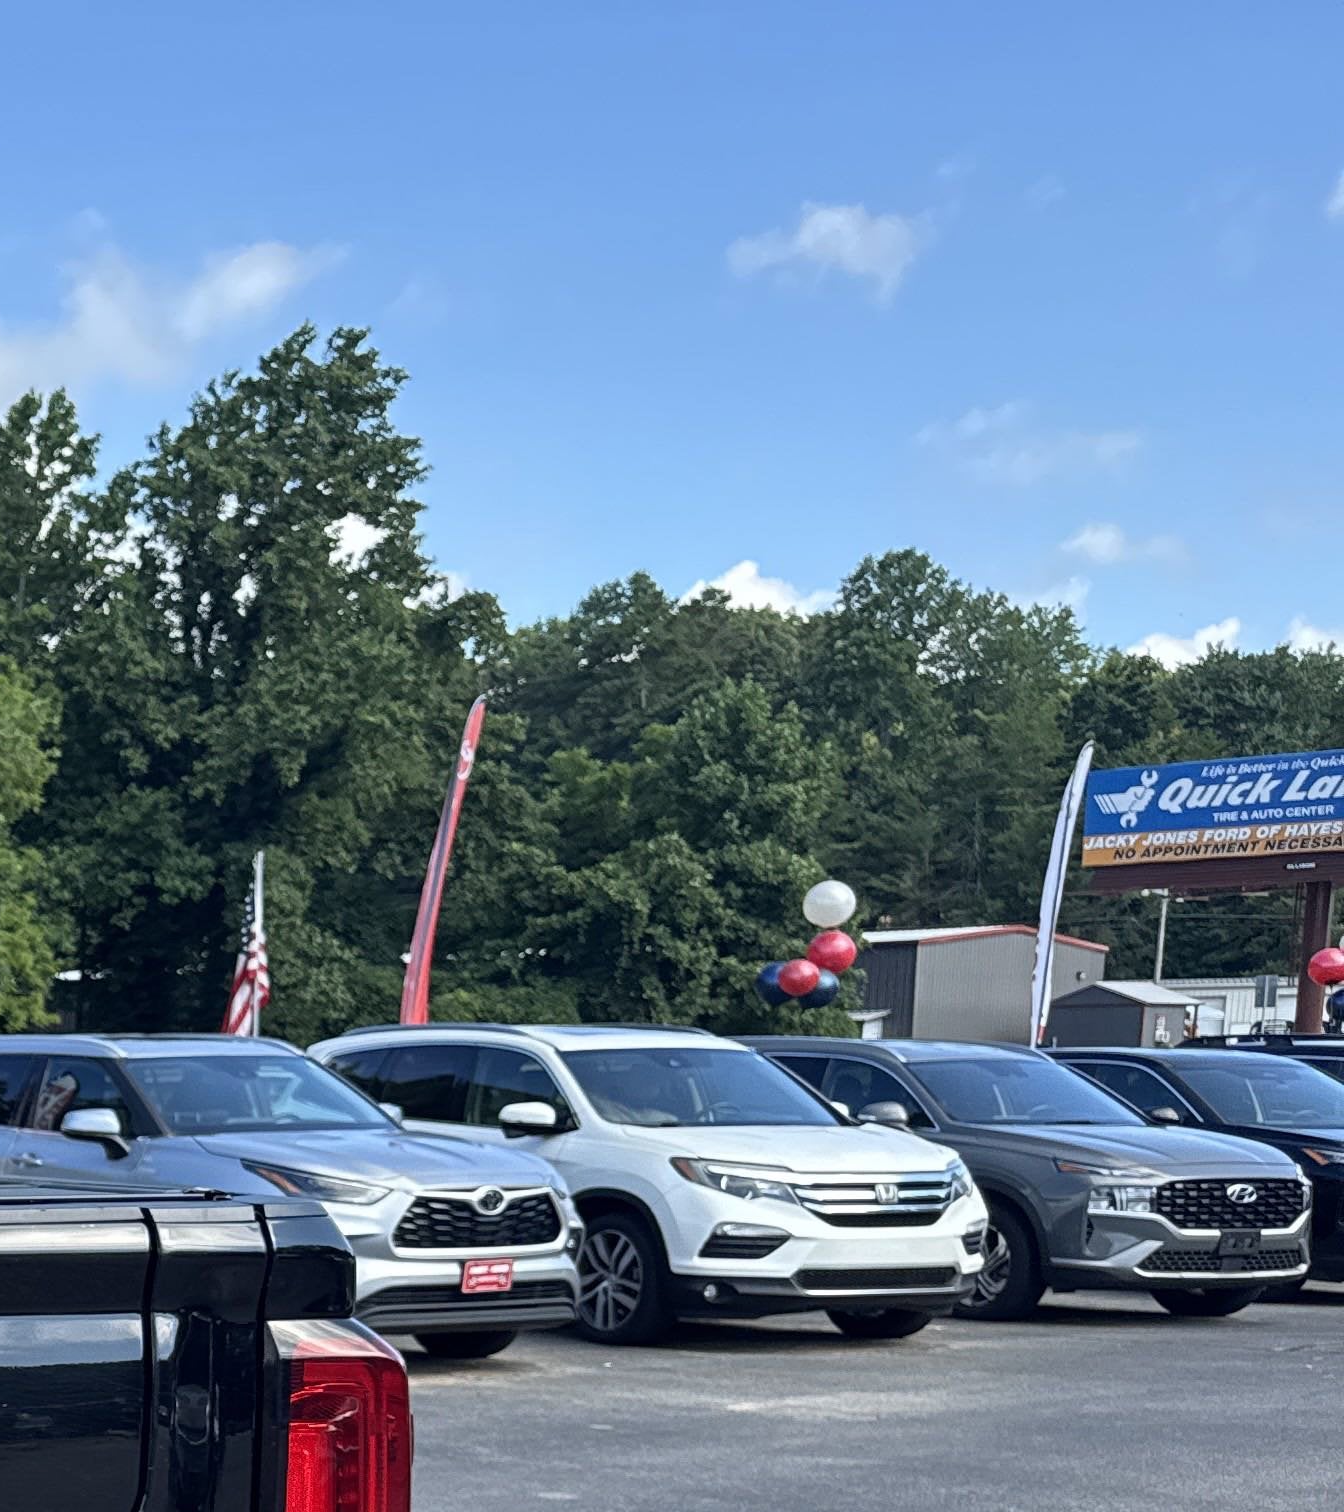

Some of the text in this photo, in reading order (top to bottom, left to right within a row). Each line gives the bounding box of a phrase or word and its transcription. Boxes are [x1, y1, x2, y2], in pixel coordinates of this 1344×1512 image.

[1158, 772, 1282, 814] Quick
[1212, 804, 1335, 823] TIRE & AUTO CENTER
[1084, 833, 1140, 849] JACKY
[1142, 830, 1199, 846] JONES
[1203, 827, 1251, 842] FORD
[1256, 824, 1282, 839] OF
[1113, 847, 1136, 860] NO
[1141, 840, 1261, 858] APPOINTMENT
